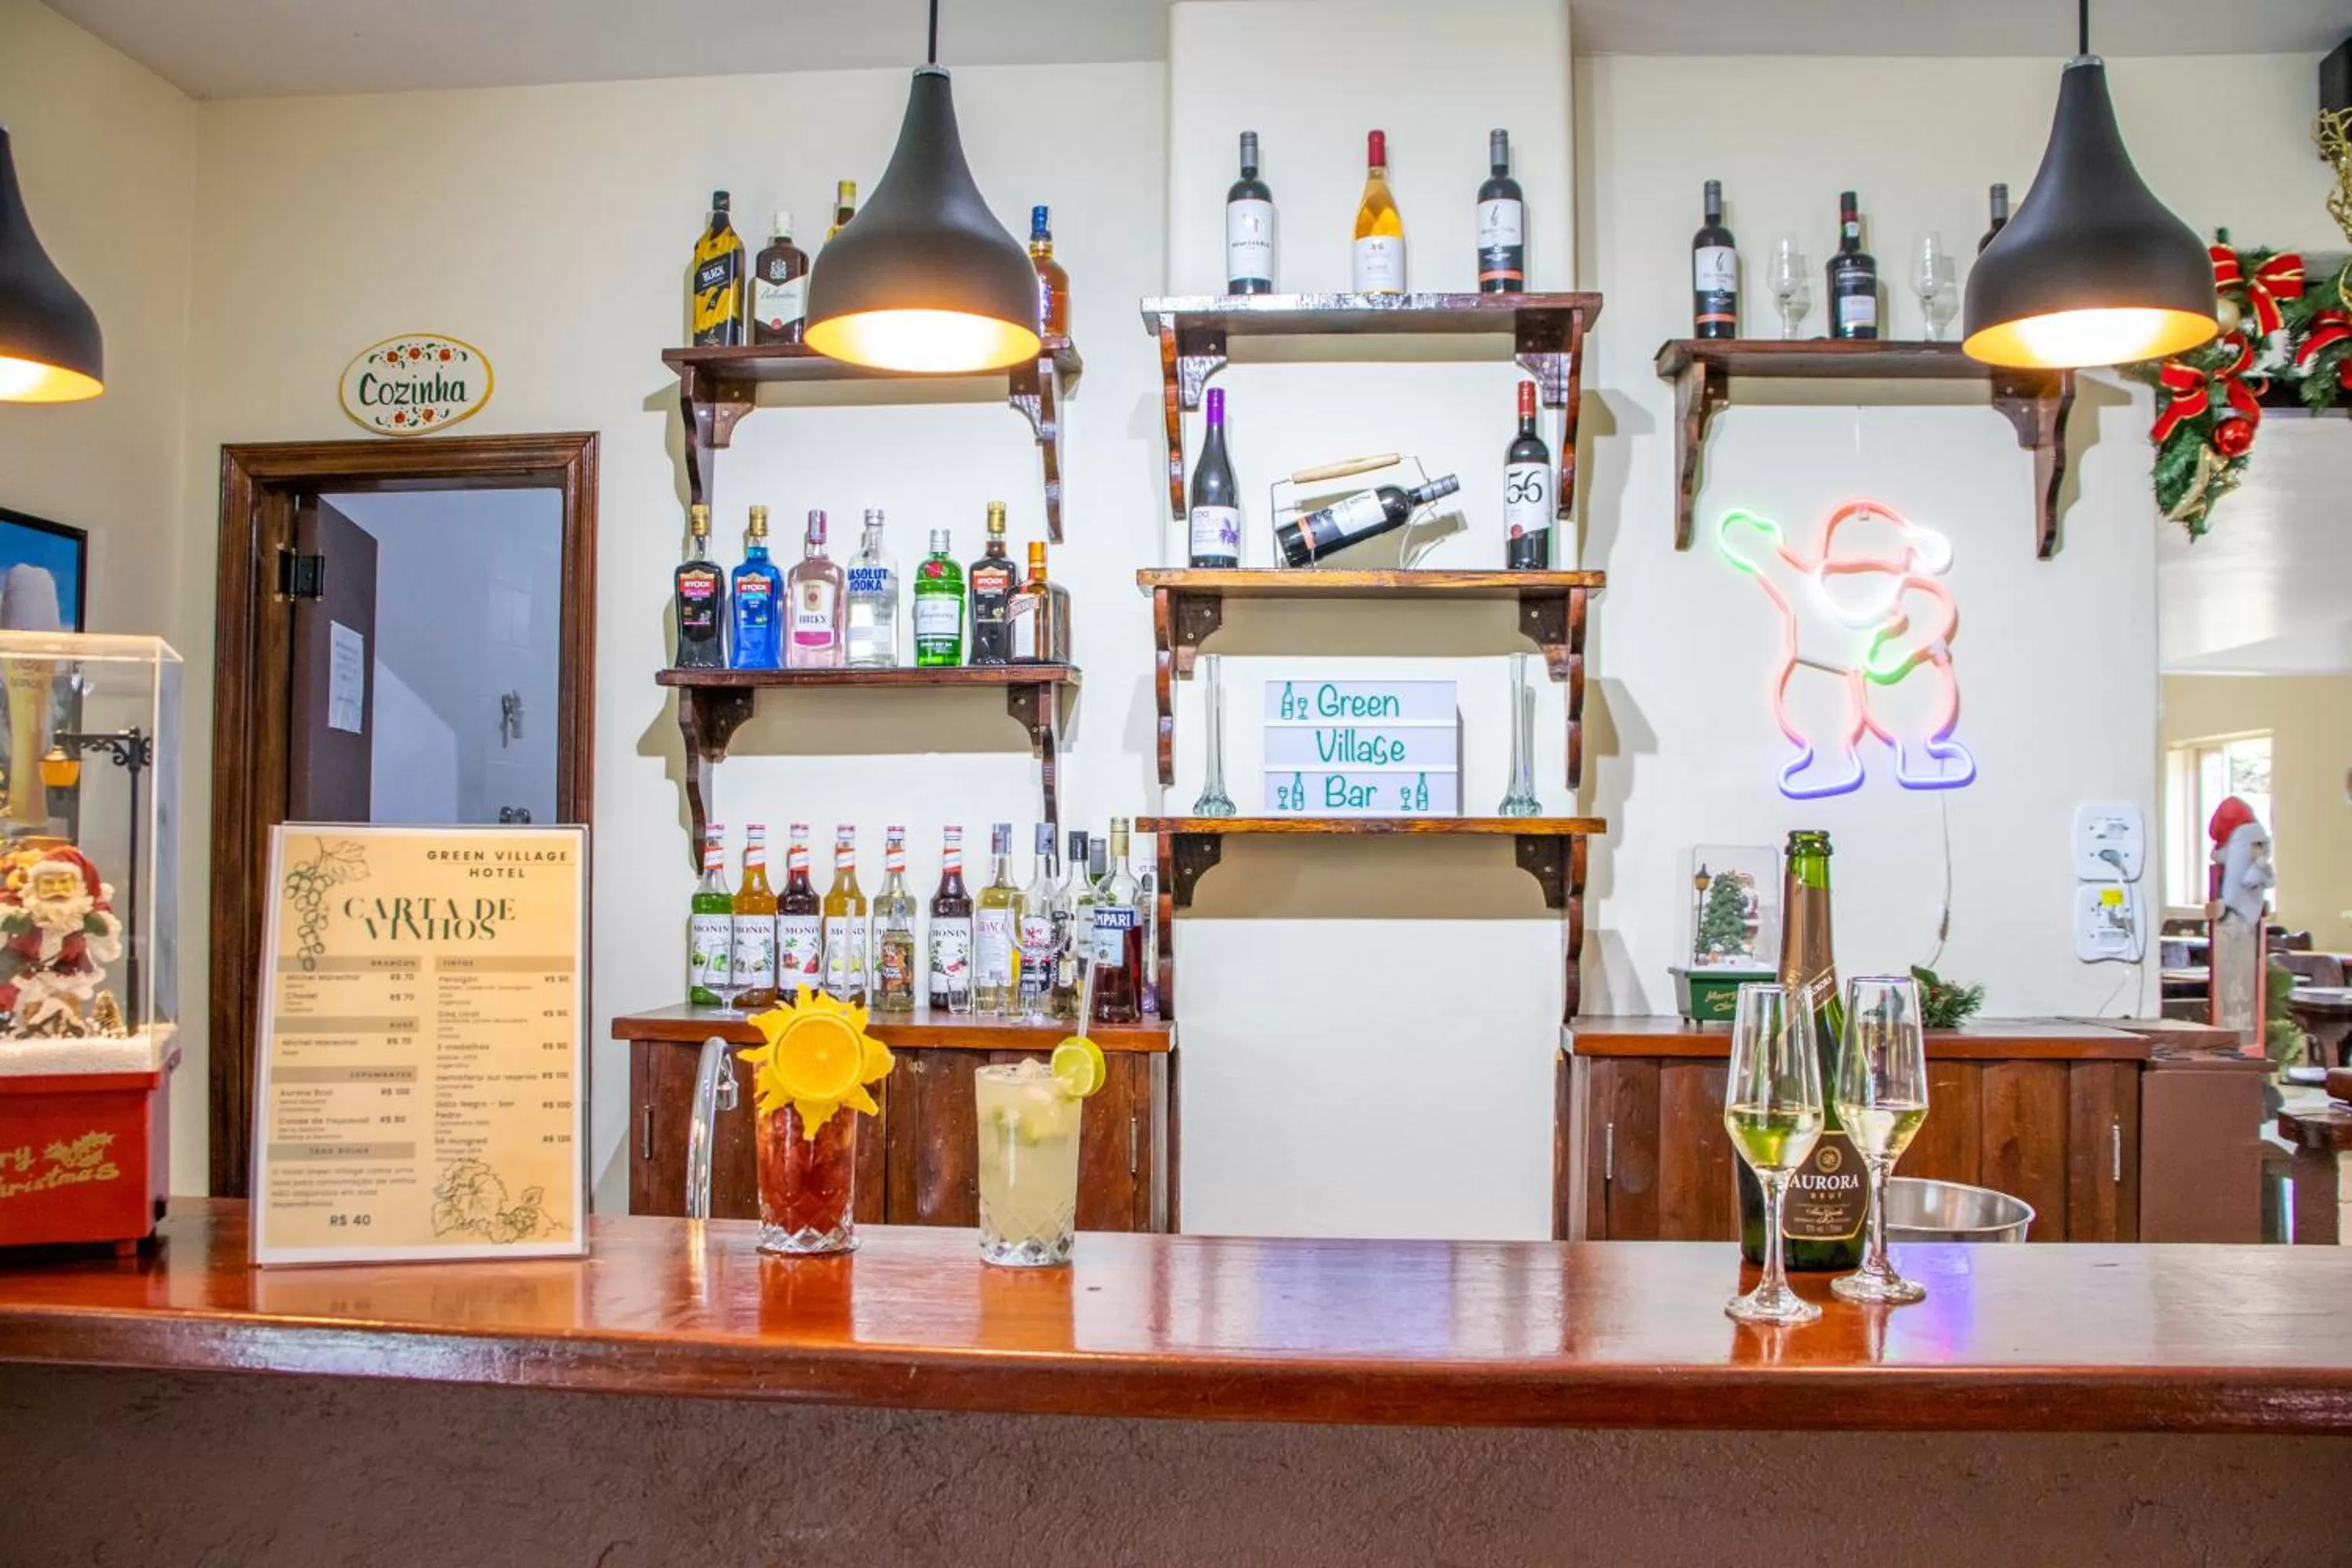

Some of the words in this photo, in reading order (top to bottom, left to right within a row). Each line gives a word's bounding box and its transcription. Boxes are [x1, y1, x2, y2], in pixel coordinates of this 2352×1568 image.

[702, 265, 726, 282] BLACK
[359, 371, 468, 406] Cozinha
[1506, 470, 1543, 504] 56
[1317, 683, 1400, 717] Green
[1316, 728, 1406, 766] Village
[1324, 773, 1378, 809] Bar
[426, 851, 485, 861] GREEN
[495, 851, 568, 862] VILLAGE
[469, 868, 525, 878] HOTEL
[344, 897, 460, 920] CARTA
[475, 898, 516, 920] DE
[1096, 913, 1131, 926] MPARI
[365, 917, 497, 941] VINHOS
[694, 925, 729, 934] MONIN
[735, 925, 771, 935] MONIN
[785, 926, 820, 935] MONIN
[931, 928, 967, 937] MONIN
[1789, 1173, 1860, 1191] AURORA
[329, 1214, 348, 1227] R$
[352, 1214, 372, 1226] 40
